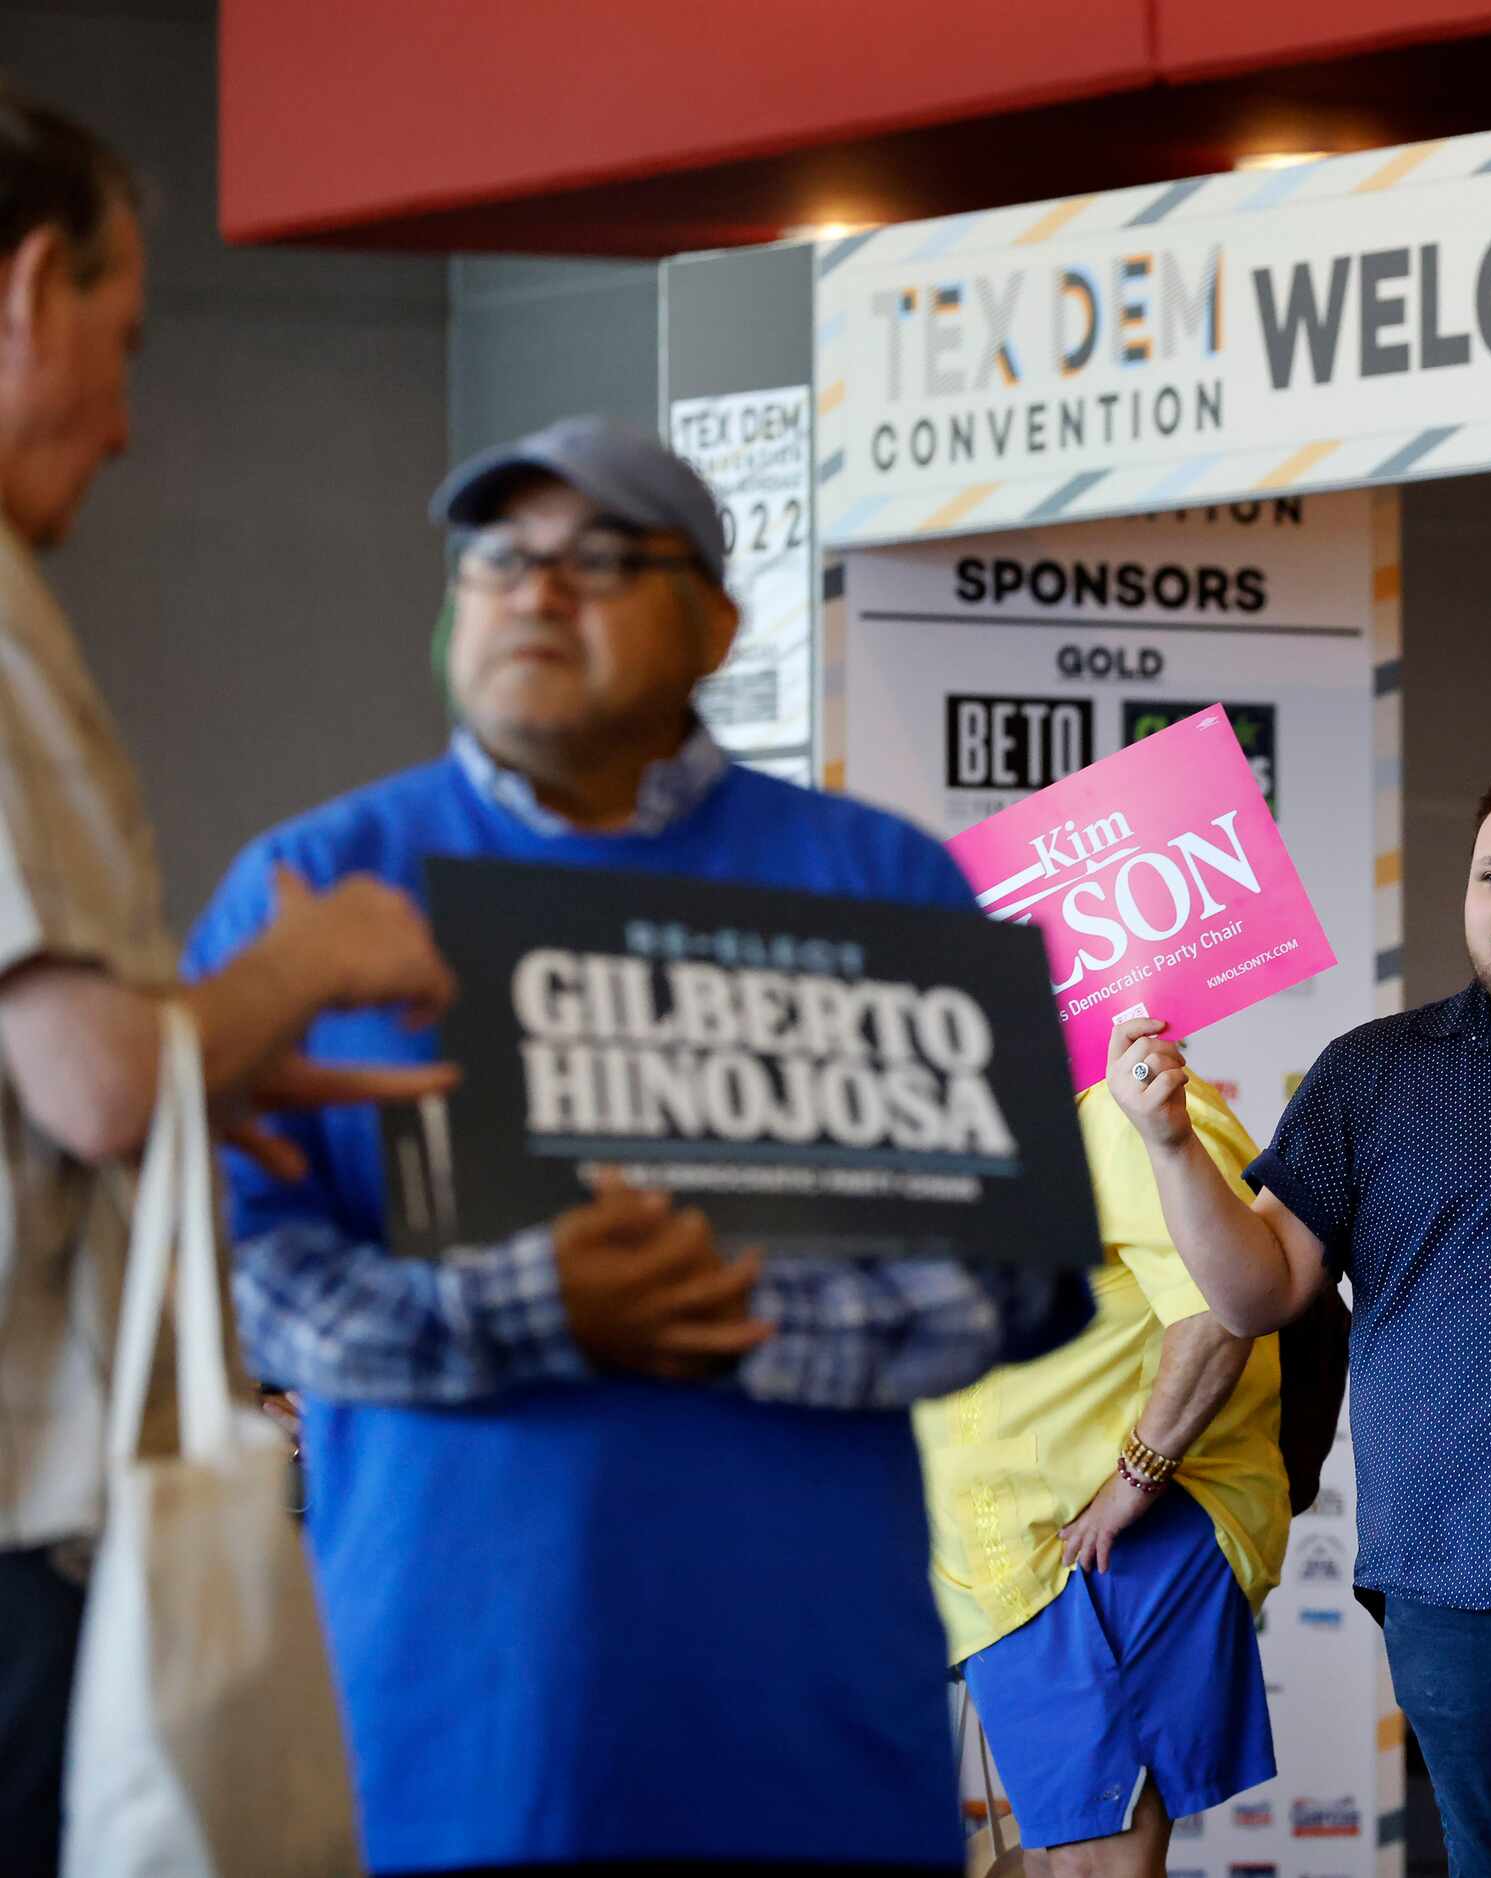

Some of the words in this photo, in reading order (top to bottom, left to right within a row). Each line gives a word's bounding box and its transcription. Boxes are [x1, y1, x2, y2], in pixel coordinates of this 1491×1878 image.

[871, 268, 1027, 403] TEX
[1053, 243, 1226, 376] DEM
[872, 381, 1223, 472] CONVENTION
[720, 499, 802, 556] 022
[955, 556, 1268, 612] SPONSORS
[1057, 645, 1164, 680] GOLD
[957, 702, 1083, 786] BETO
[1029, 810, 1135, 879] Kim
[1068, 965, 1153, 1016] Democratic
[1153, 942, 1198, 972] Party
[1200, 919, 1244, 948] Chair
[1207, 939, 1299, 989] KIMOLSONTX.COM
[512, 948, 994, 1078] GILBERTO
[523, 1040, 1018, 1158] HINOJOSA
